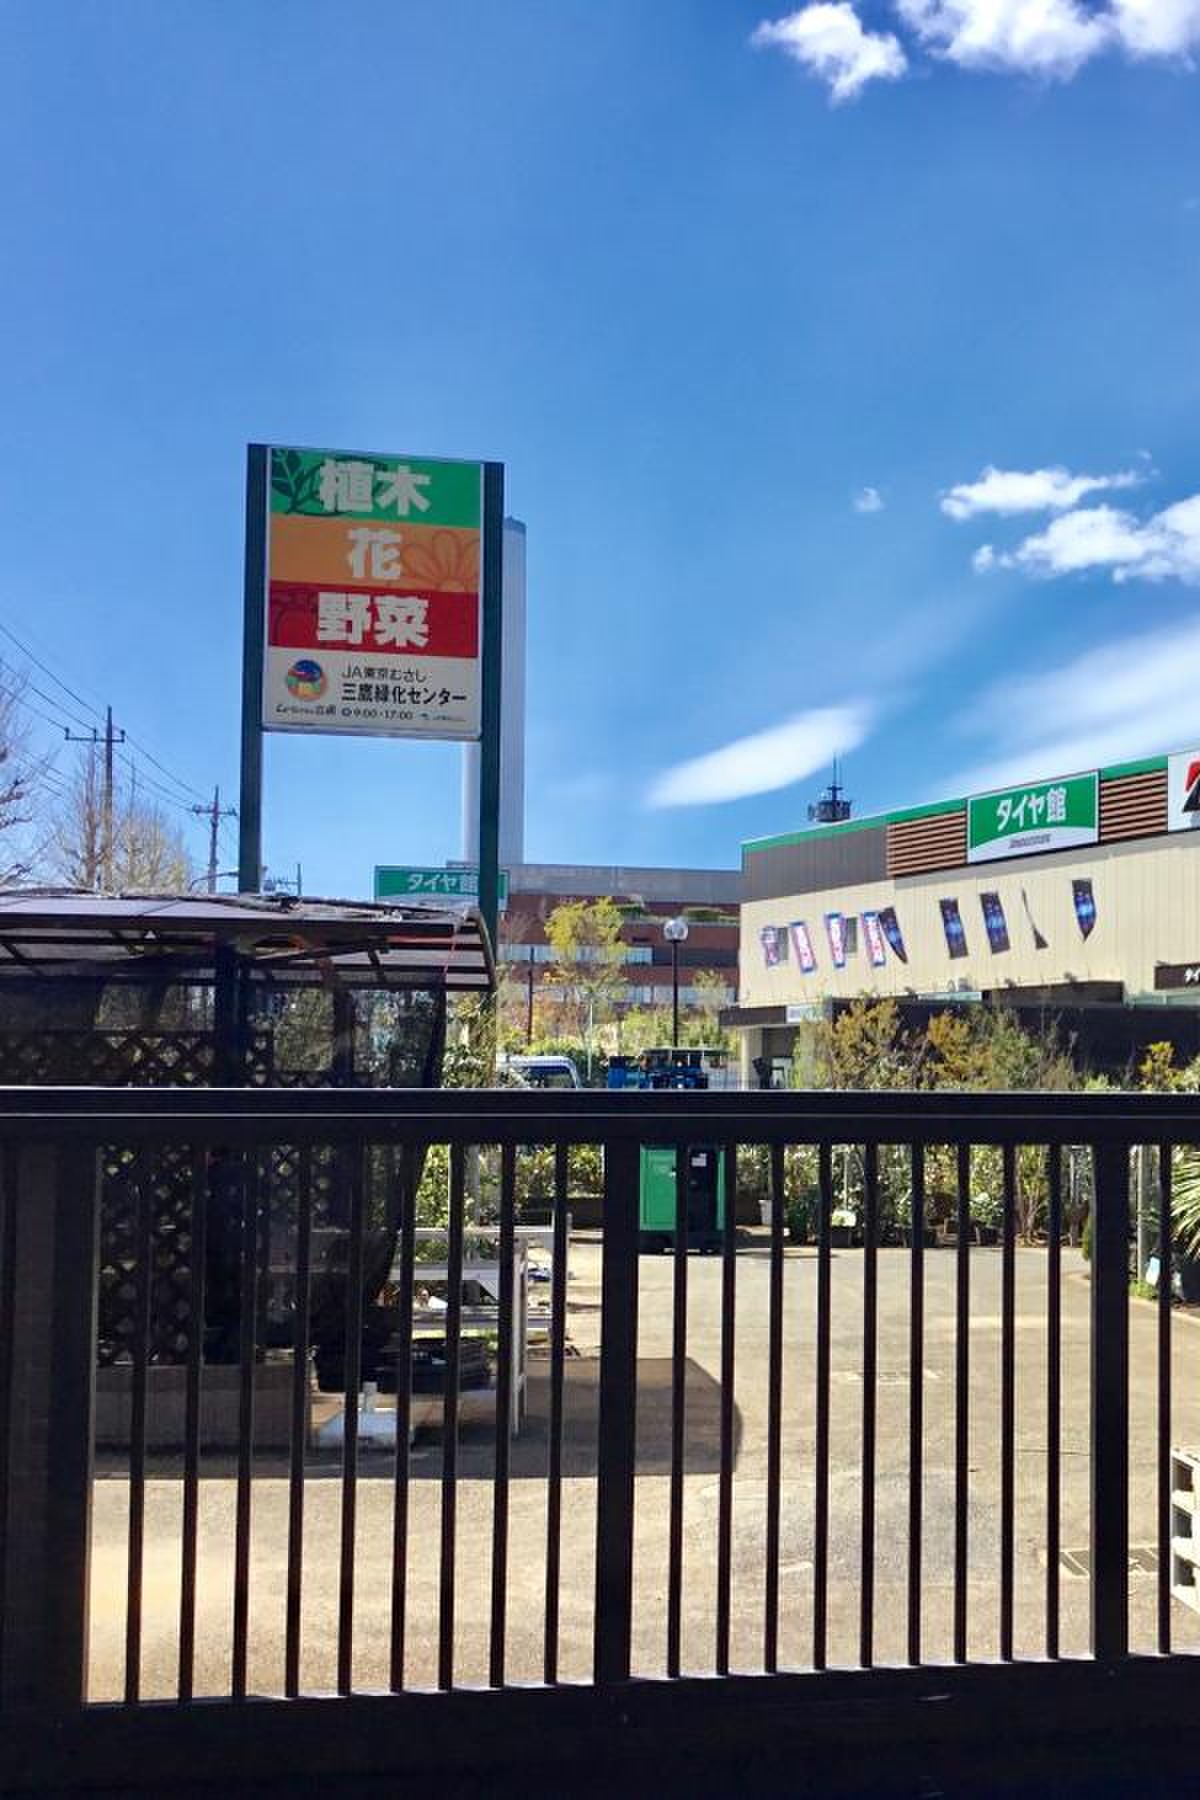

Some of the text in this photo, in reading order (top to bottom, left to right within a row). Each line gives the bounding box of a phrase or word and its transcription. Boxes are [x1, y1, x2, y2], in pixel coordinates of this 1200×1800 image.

[319, 459, 431, 515] 植木
[348, 528, 403, 580] 花
[317, 591, 430, 647] 野菜
[341, 666, 427, 682] JA東京むさし
[341, 683, 467, 705] 三鷹緑化センター
[996, 786, 1067, 832] タイヤ館
[407, 873, 479, 892] タイヤ館
